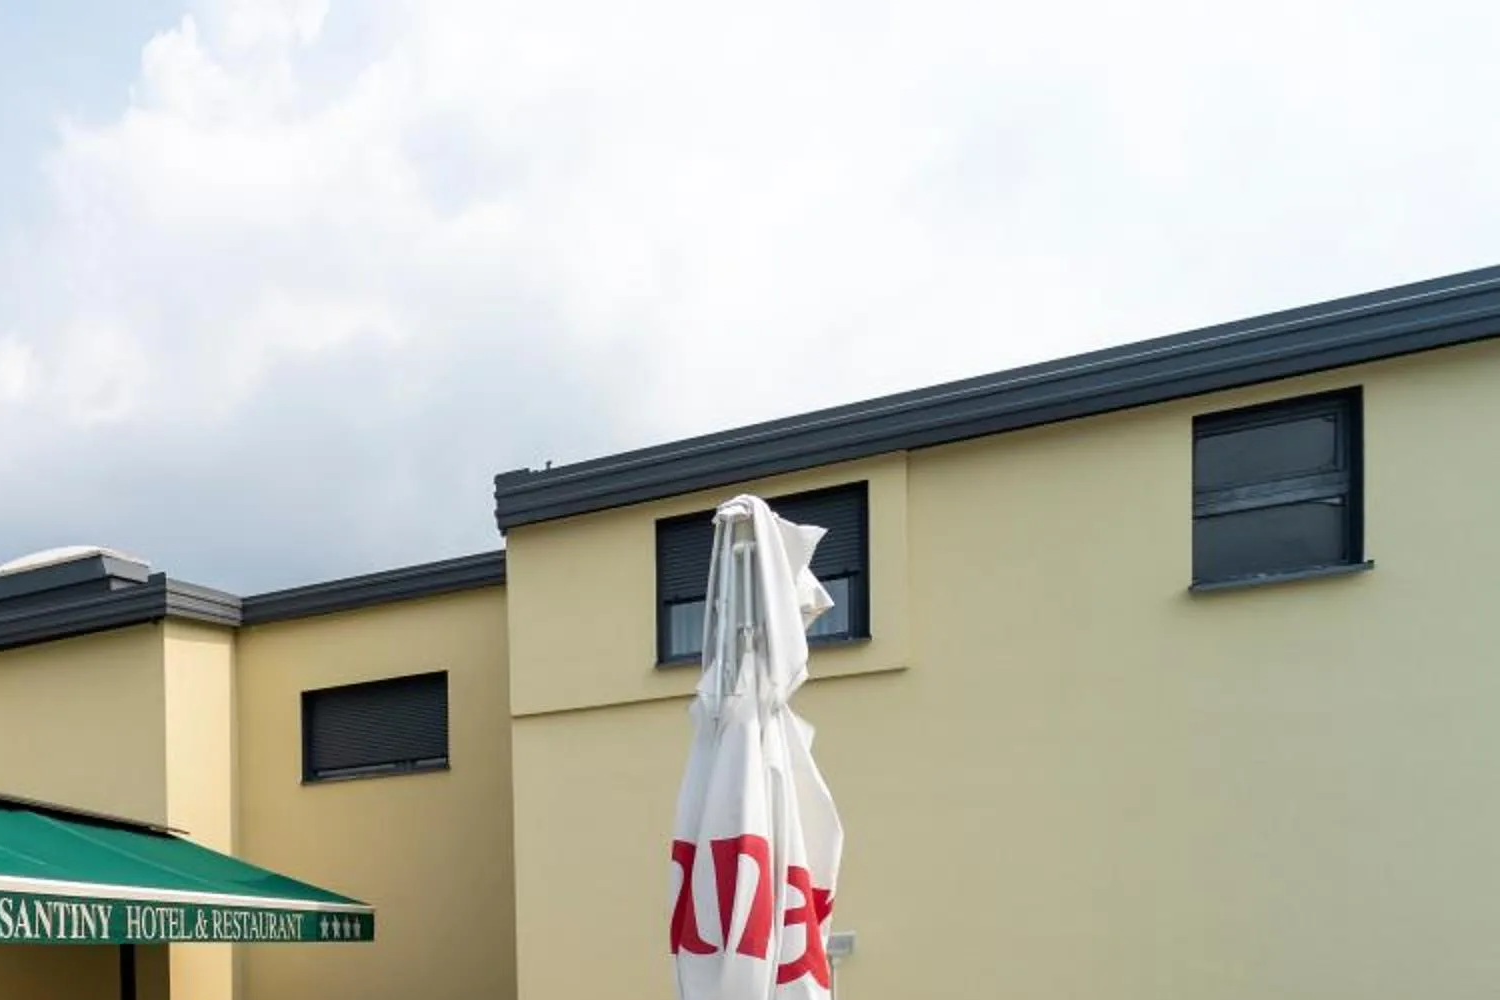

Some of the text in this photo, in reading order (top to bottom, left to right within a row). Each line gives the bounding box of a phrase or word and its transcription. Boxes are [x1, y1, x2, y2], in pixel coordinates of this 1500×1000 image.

[126, 905, 192, 940] HOTEL
[196, 906, 210, 939] &
[212, 911, 304, 940] RESTAURANT
